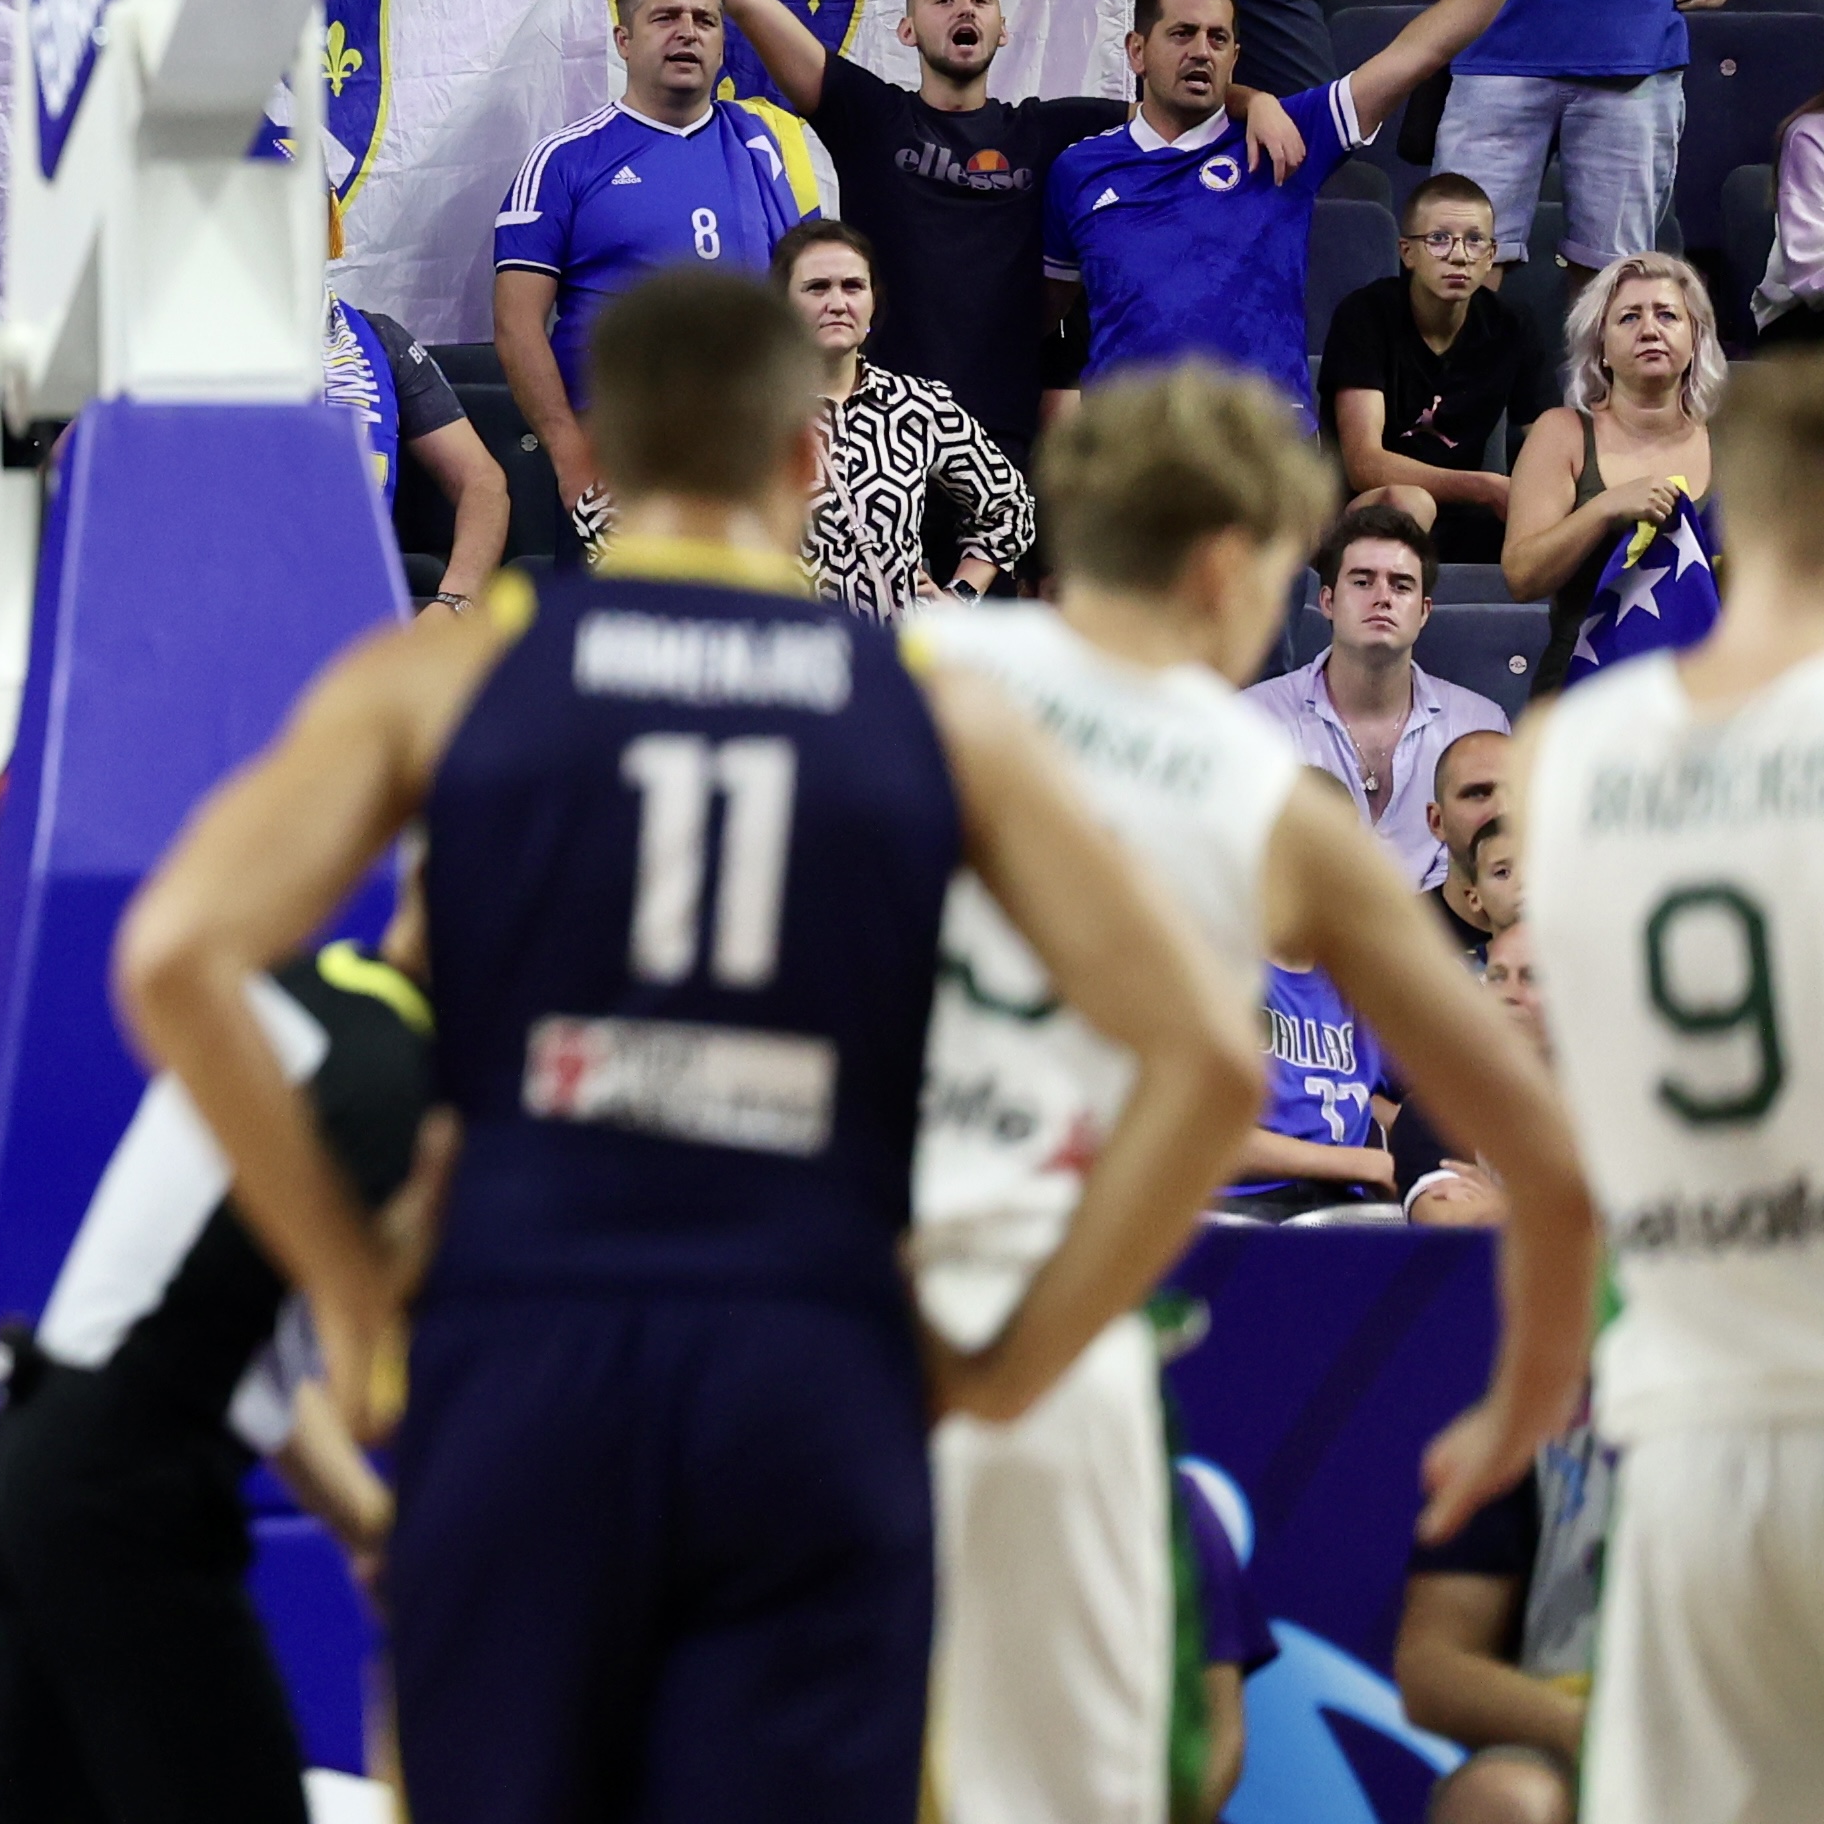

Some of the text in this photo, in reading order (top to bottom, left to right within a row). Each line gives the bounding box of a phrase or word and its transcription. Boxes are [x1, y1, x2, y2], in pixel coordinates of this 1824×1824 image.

[691, 207, 721, 260] 8
[894, 142, 1034, 191] ellesse
[618, 731, 798, 992] 11
[1645, 883, 1784, 1126] 9
